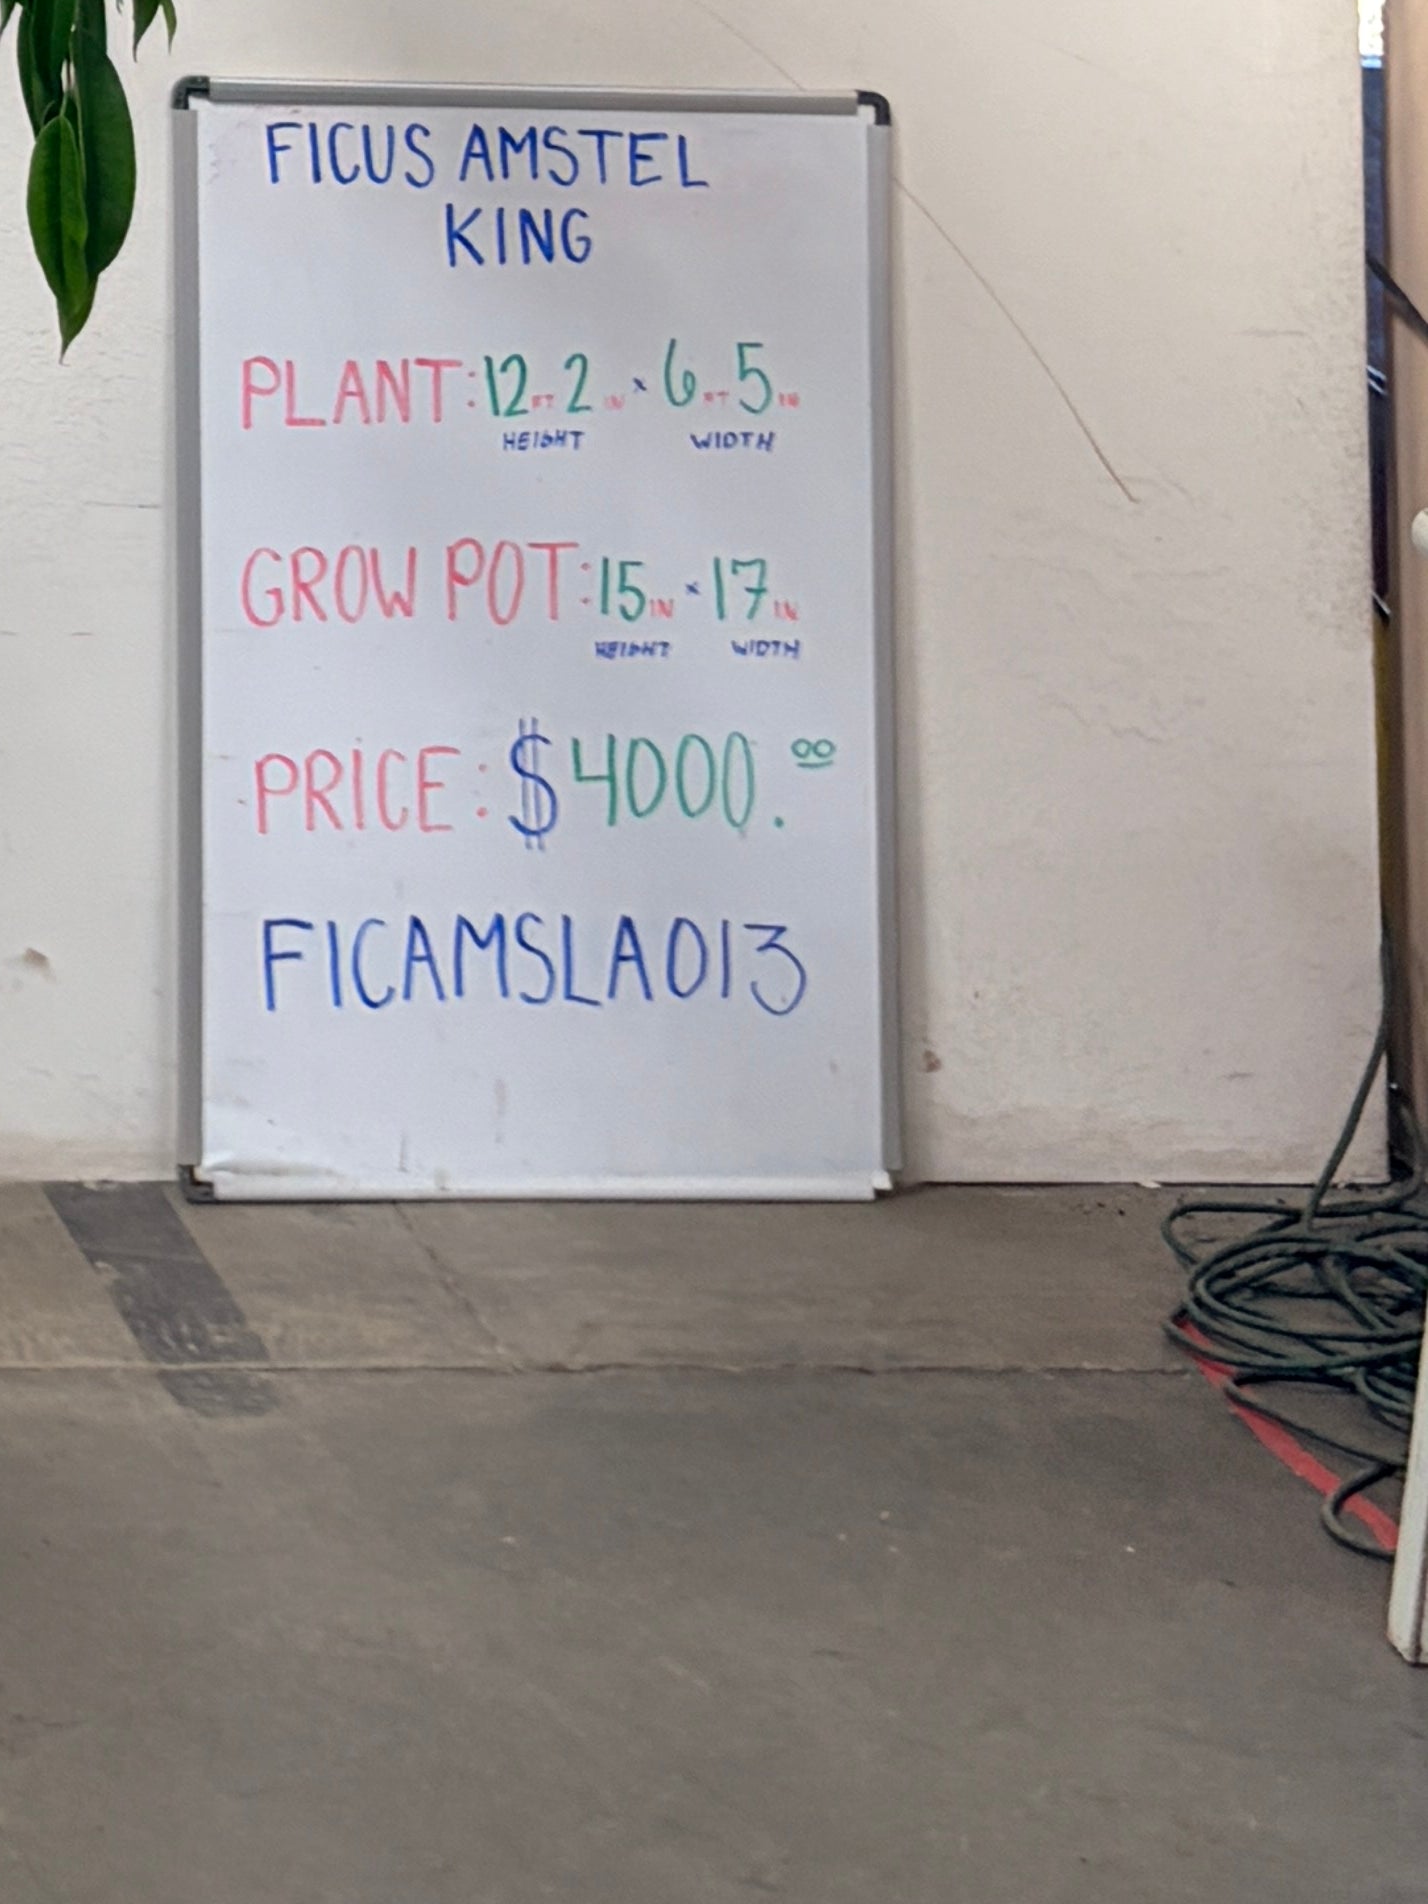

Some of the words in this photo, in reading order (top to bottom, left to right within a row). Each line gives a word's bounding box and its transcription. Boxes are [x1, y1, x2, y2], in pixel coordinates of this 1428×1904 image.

[266, 122, 435, 188] FICUS
[459, 122, 710, 188] AMSTEL
[445, 202, 593, 267] KING
[242, 355, 476, 430] PLANT:
[502, 428, 586, 452] HEIGHT
[689, 430, 777, 453] WIDTH
[242, 545, 418, 629] GROW
[445, 537, 592, 625] POT:
[730, 638, 802, 660] WIDTH
[254, 745, 489, 835] PRICE:
